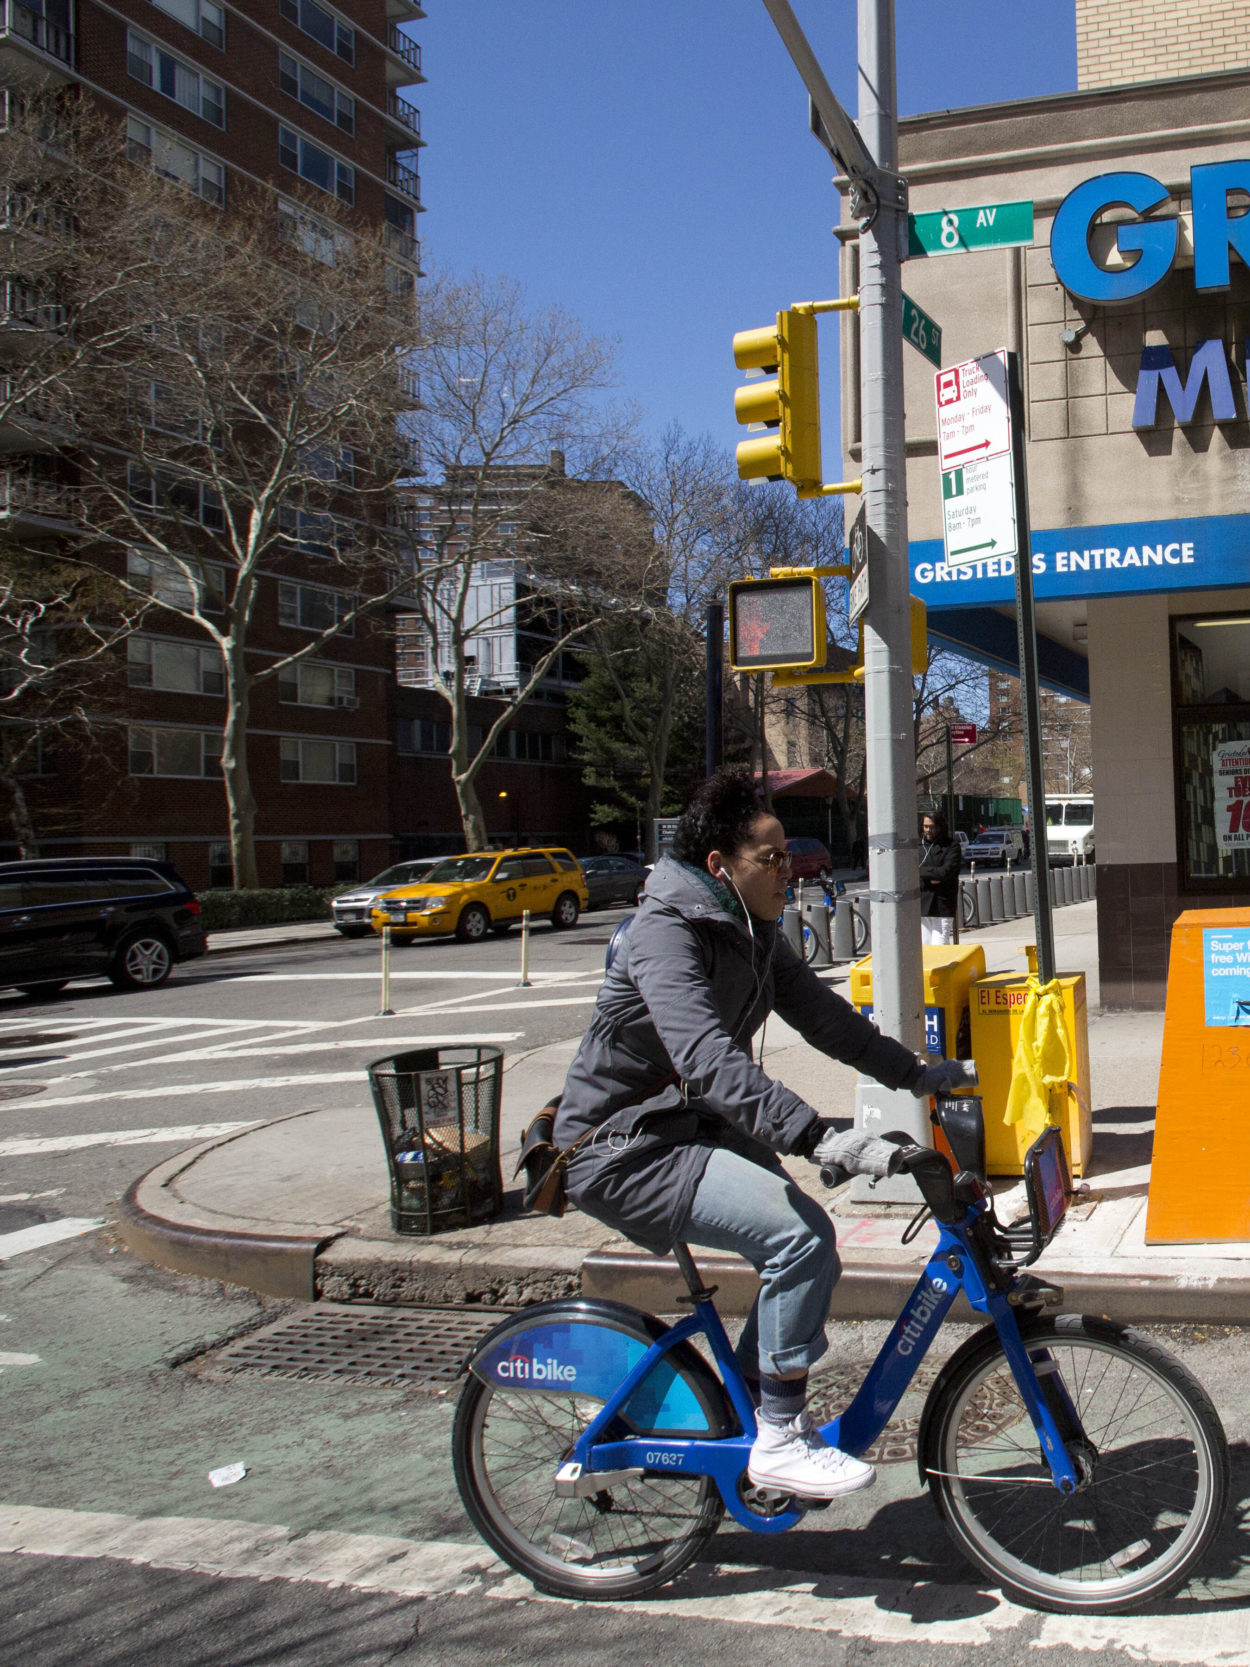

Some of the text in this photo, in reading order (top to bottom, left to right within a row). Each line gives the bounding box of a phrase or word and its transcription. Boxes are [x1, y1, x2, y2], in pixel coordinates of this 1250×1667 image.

[940, 208, 997, 248] 8 AV
[910, 308, 940, 350] 26 ST
[962, 363, 980, 377] Truck
[962, 375, 989, 388] Loading
[963, 387, 977, 400] Only
[941, 413, 965, 427] Monday
[971, 404, 992, 417] Friday
[961, 424, 975, 435] 7pm
[949, 471, 957, 496] 1
[966, 471, 989, 484] metered
[966, 483, 987, 496] parking
[947, 505, 977, 520] Saturday
[948, 521, 962, 532] 8am
[967, 517, 981, 529] 7pm
[914, 542, 1194, 584] GRISTEDS ENTRANCE
[1219, 768, 1242, 776] SENIORS
[1223, 834, 1233, 842] ON
[1234, 833, 1245, 841] ALL
[1211, 940, 1244, 953] Super
[1211, 953, 1233, 963] free
[980, 990, 990, 1005] El
[896, 1278, 947, 1356] citi bike
[497, 1356, 577, 1381] citi bike
